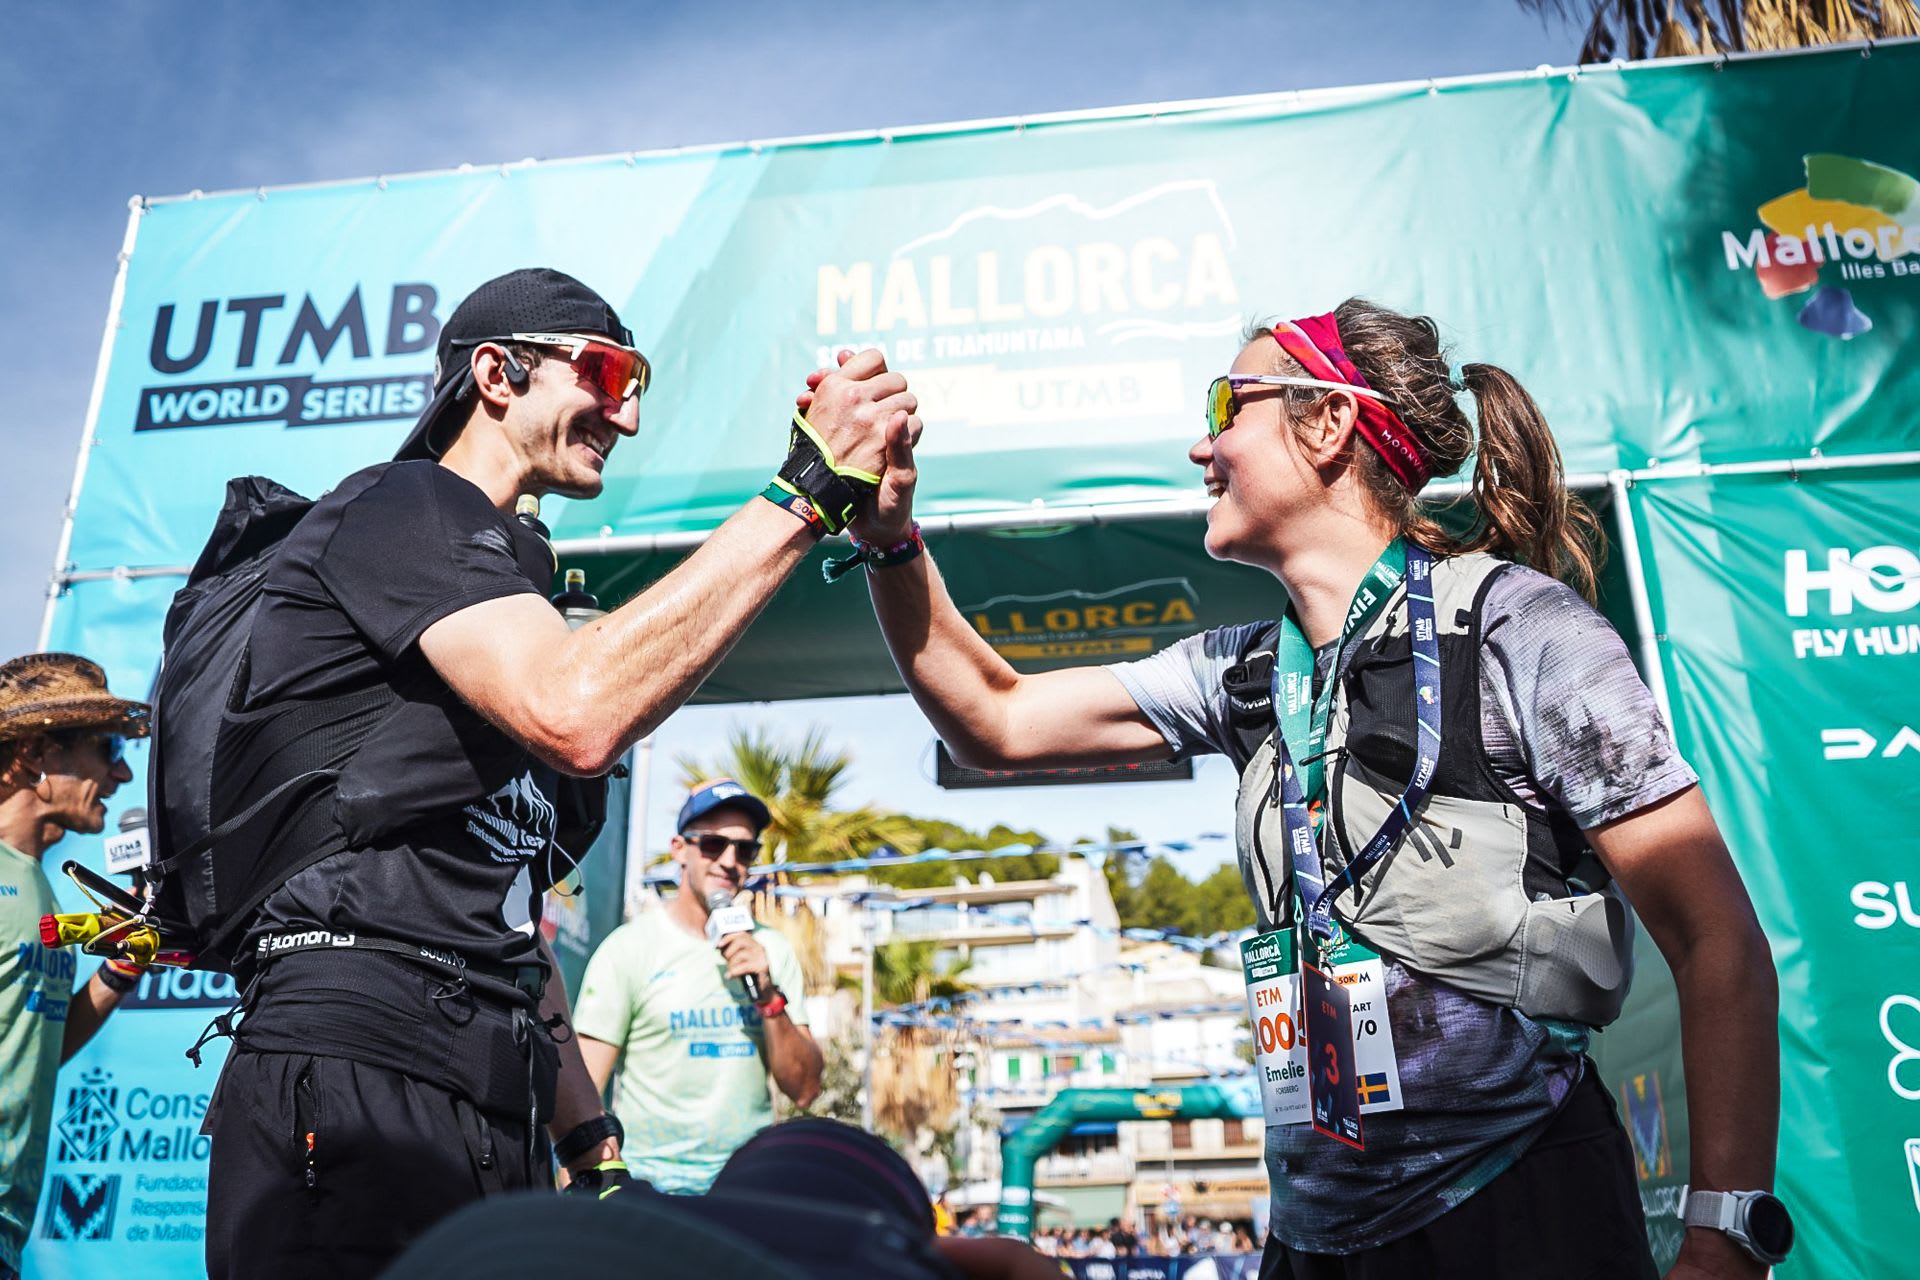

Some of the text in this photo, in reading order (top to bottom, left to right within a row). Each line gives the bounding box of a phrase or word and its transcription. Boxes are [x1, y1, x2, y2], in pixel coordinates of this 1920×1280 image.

[1840, 260, 1885, 280] Illes
[817, 232, 1239, 336] MALLORCA
[149, 282, 441, 375] UTMB
[896, 339, 926, 362] DE
[932, 327, 1086, 357] TRAMUNTANA
[150, 380, 426, 424] WORLD SERIES
[1017, 375, 1141, 410] UTMB
[1792, 628, 1848, 659] FLY
[109, 840, 142, 856] UTMB
[1244, 943, 1282, 965] MALLORCA
[1338, 976, 1356, 985] 50K
[1256, 986, 1283, 1008] ETM
[1321, 1001, 1337, 1020] ETM
[1265, 1060, 1306, 1082] Emelie
[1325, 1043, 1340, 1085] 3
[119, 1126, 212, 1161] Mallo
[126, 1225, 149, 1242] de
